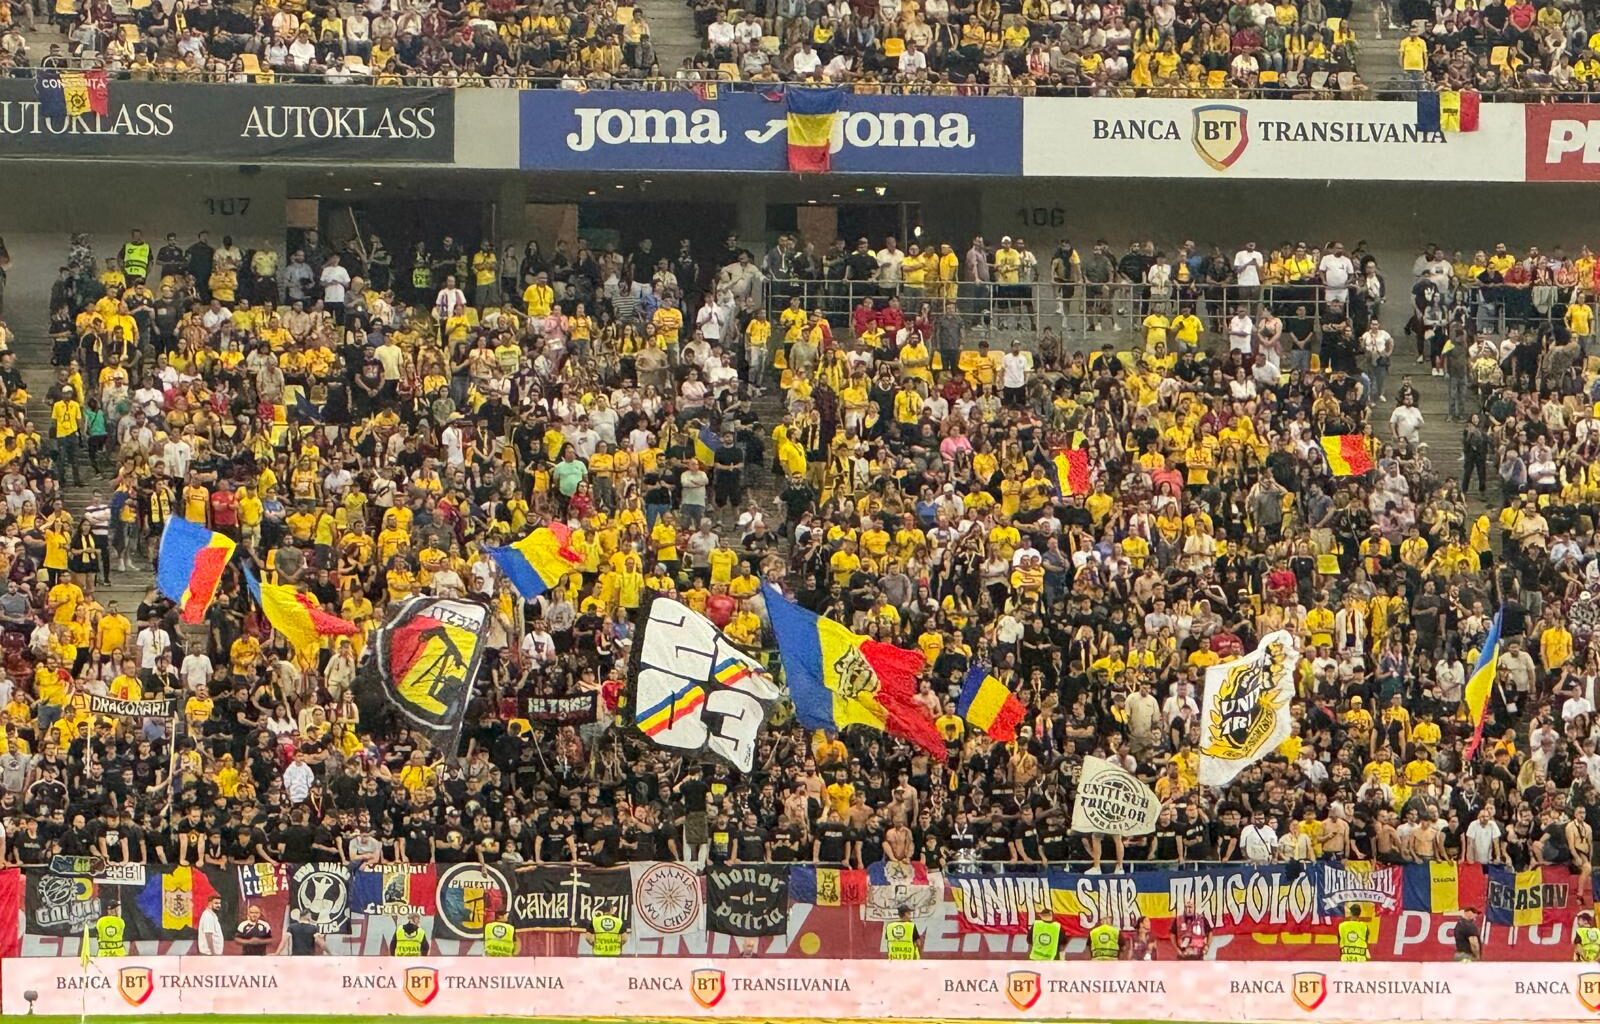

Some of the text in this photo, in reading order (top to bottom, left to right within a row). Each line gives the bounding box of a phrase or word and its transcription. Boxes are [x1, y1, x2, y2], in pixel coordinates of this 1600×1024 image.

[0, 101, 174, 136] UTOKLASS
[240, 106, 436, 140] AUTOKLASS
[1092, 119, 1448, 144] BANCA BT TRANSILVANIA
[205, 197, 251, 216] 107
[1017, 207, 1065, 228] 106
[1080, 796, 1147, 823] TRICOLOR
[1488, 881, 1569, 911] BRASOV
[57, 975, 278, 989] BANCA BT TRANSILVANIA
[342, 975, 564, 990] BANCA BT TRANSILVANIA
[628, 977, 851, 992] BANCA BT TRANSILVANIA
[944, 979, 1167, 993] BANCA BT TRANSILVANIA
[1230, 981, 1451, 994] BANCA BT TRANSILVANIA
[1514, 981, 1570, 994] BANCA
